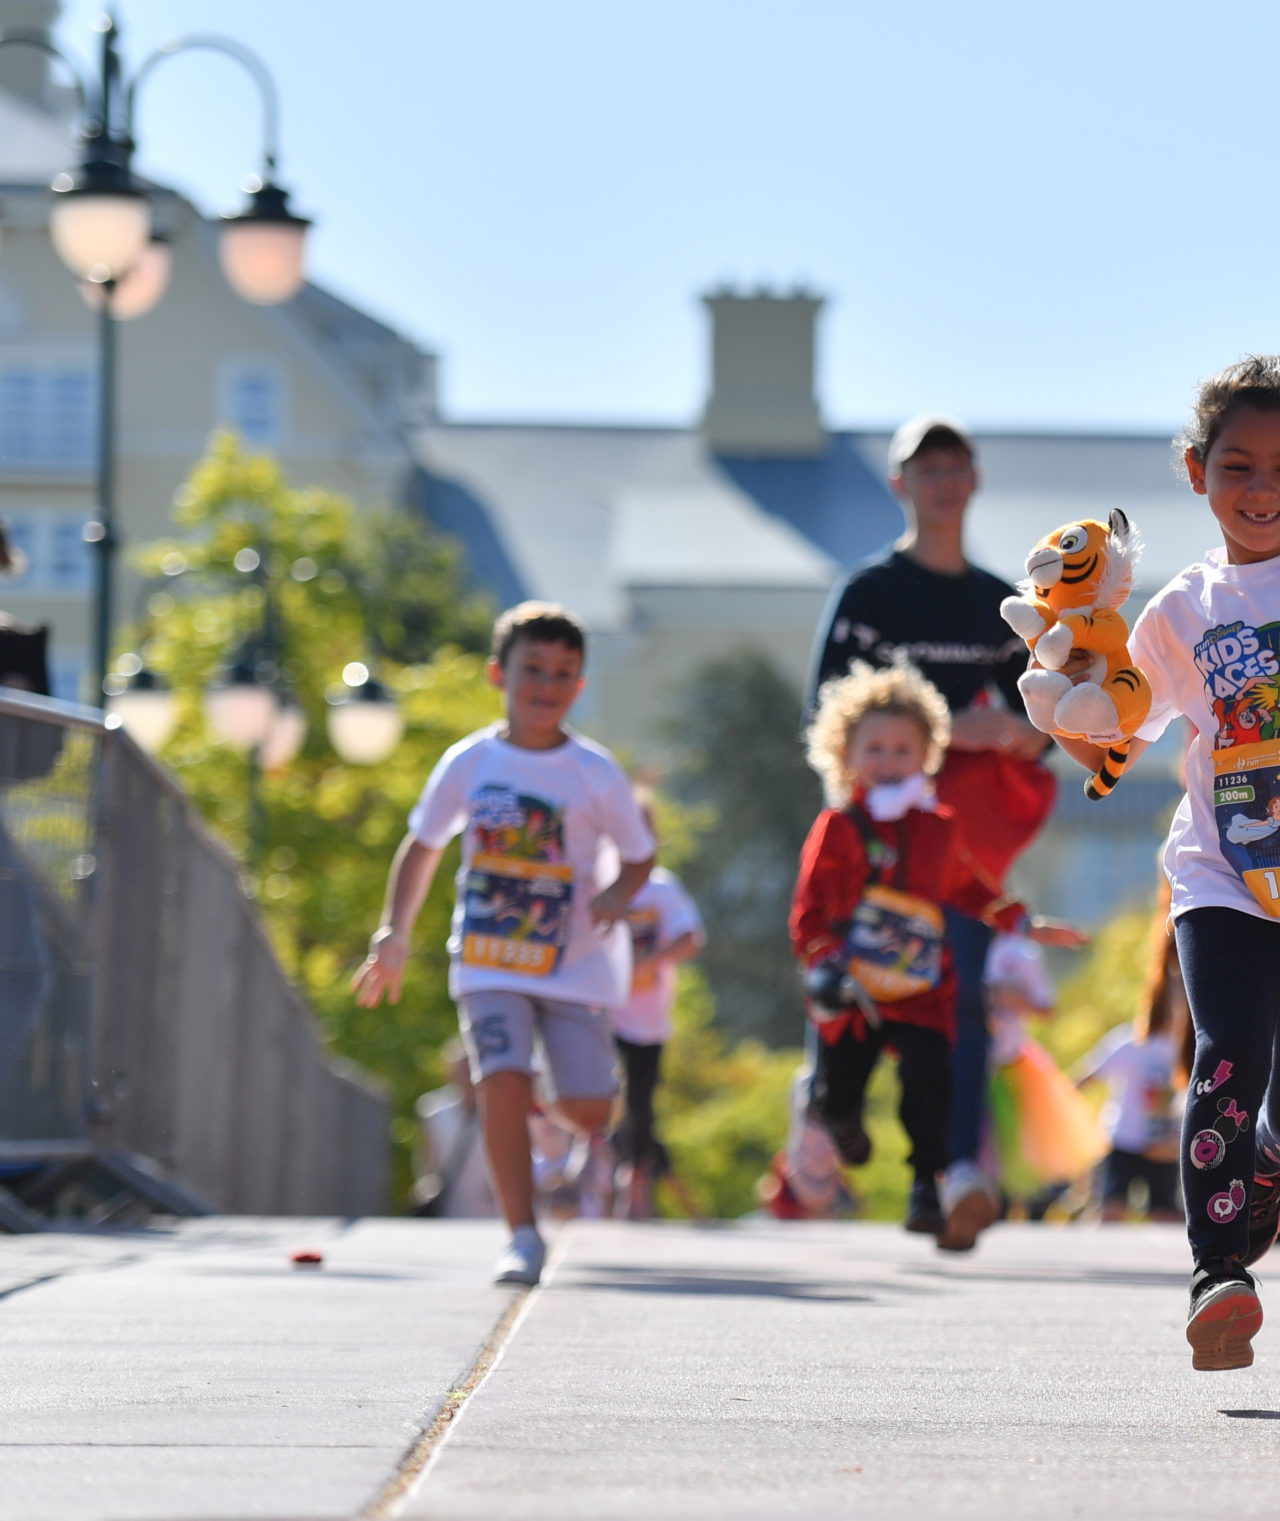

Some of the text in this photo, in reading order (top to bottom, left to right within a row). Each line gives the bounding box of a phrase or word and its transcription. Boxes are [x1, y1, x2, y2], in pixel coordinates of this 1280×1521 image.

[1206, 649, 1280, 701] ACES
[1218, 774, 1248, 788] 11236
[1219, 790, 1249, 803] 200m
